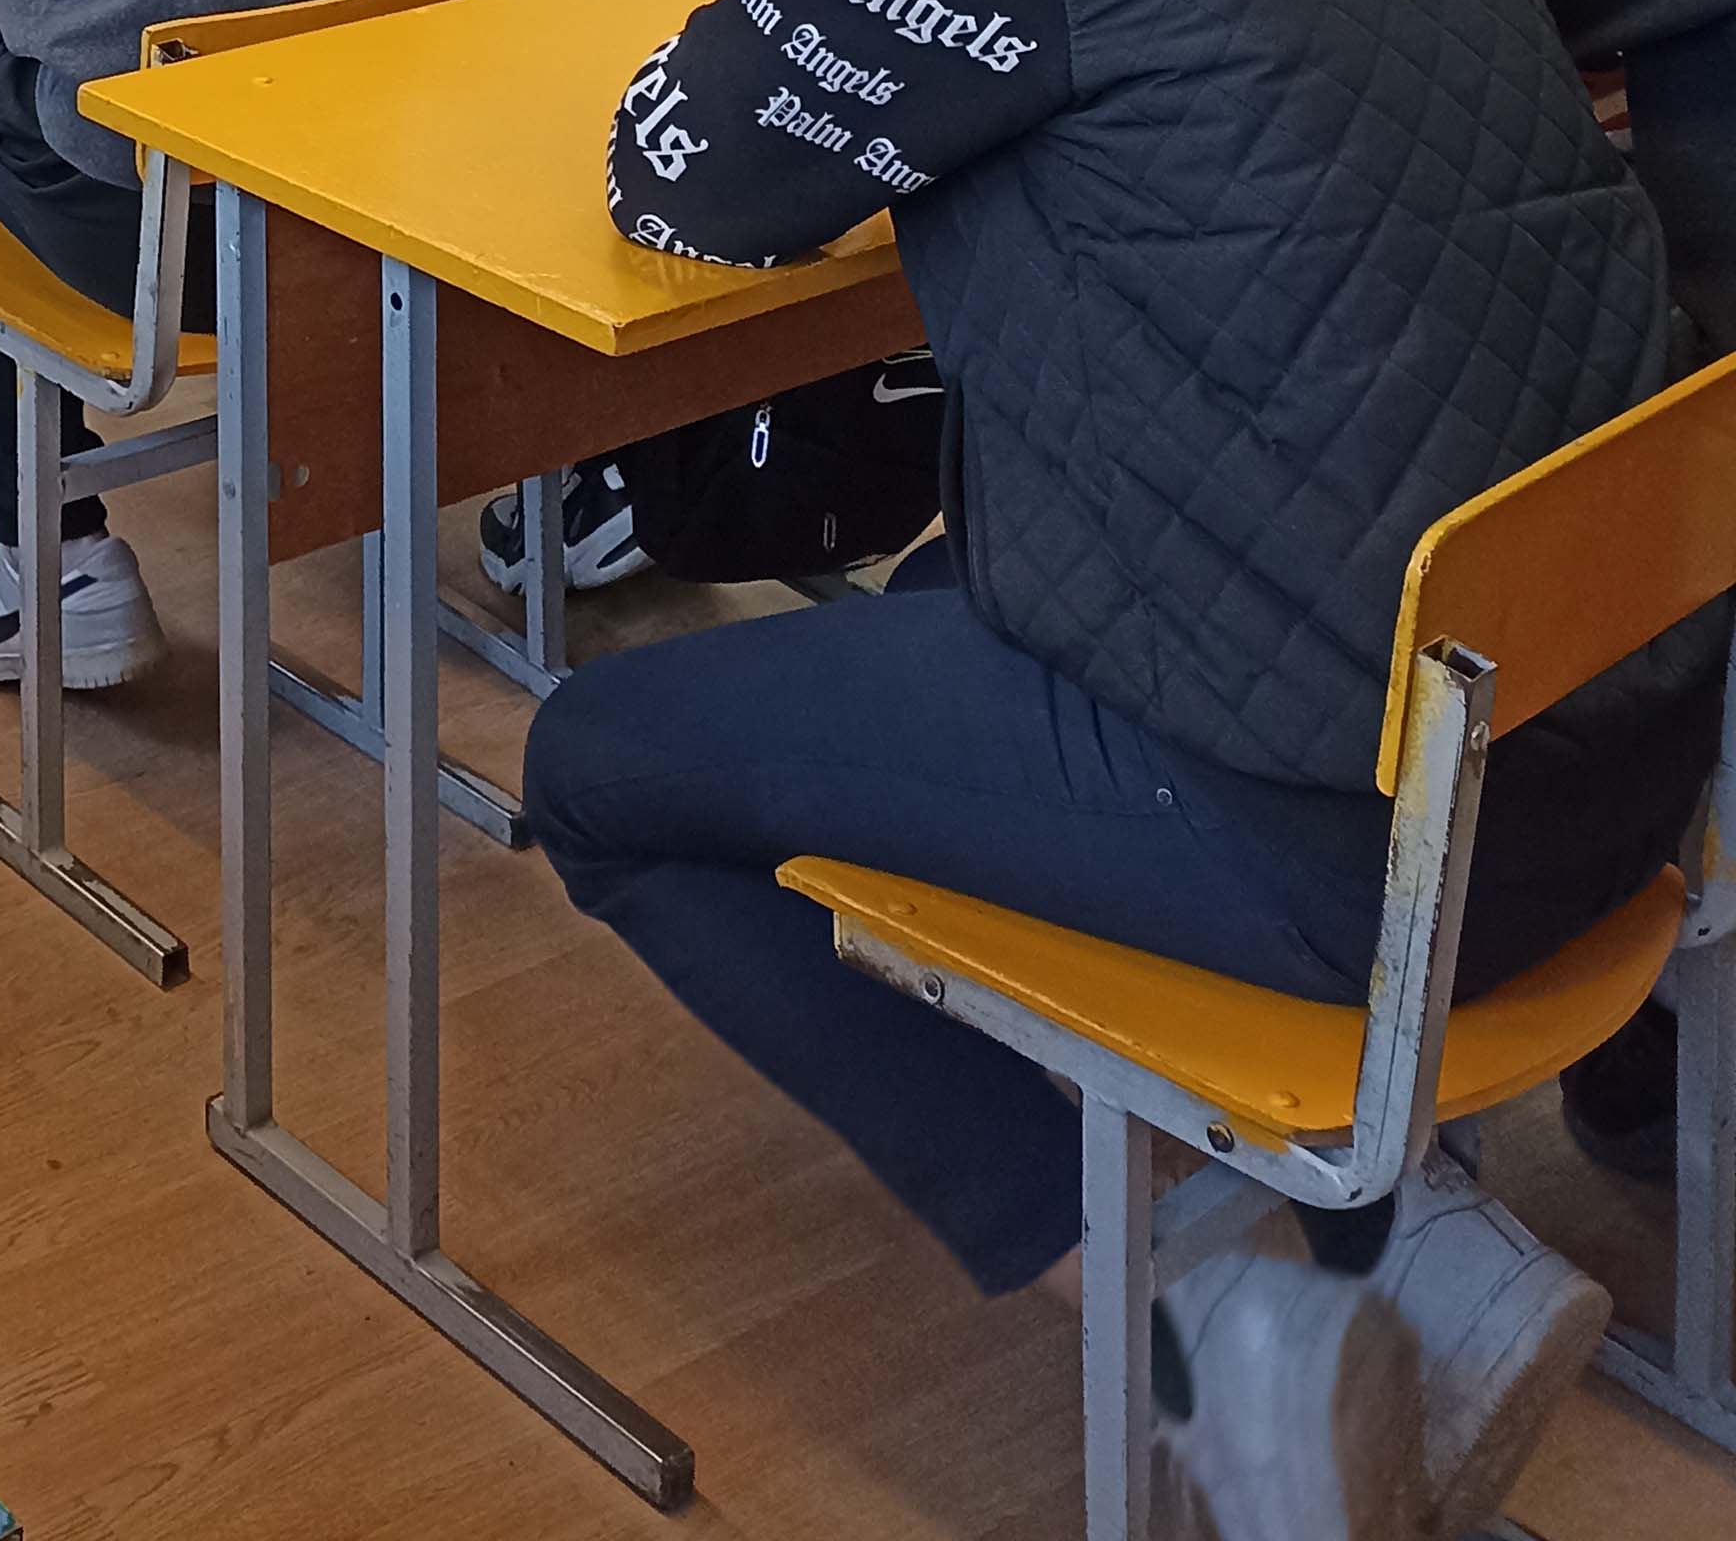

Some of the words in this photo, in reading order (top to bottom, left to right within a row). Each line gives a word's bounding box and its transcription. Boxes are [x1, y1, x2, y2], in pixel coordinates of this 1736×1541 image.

[780, 22, 904, 105] Angels
[754, 86, 852, 152] Palm
[853, 137, 939, 194] Ang
